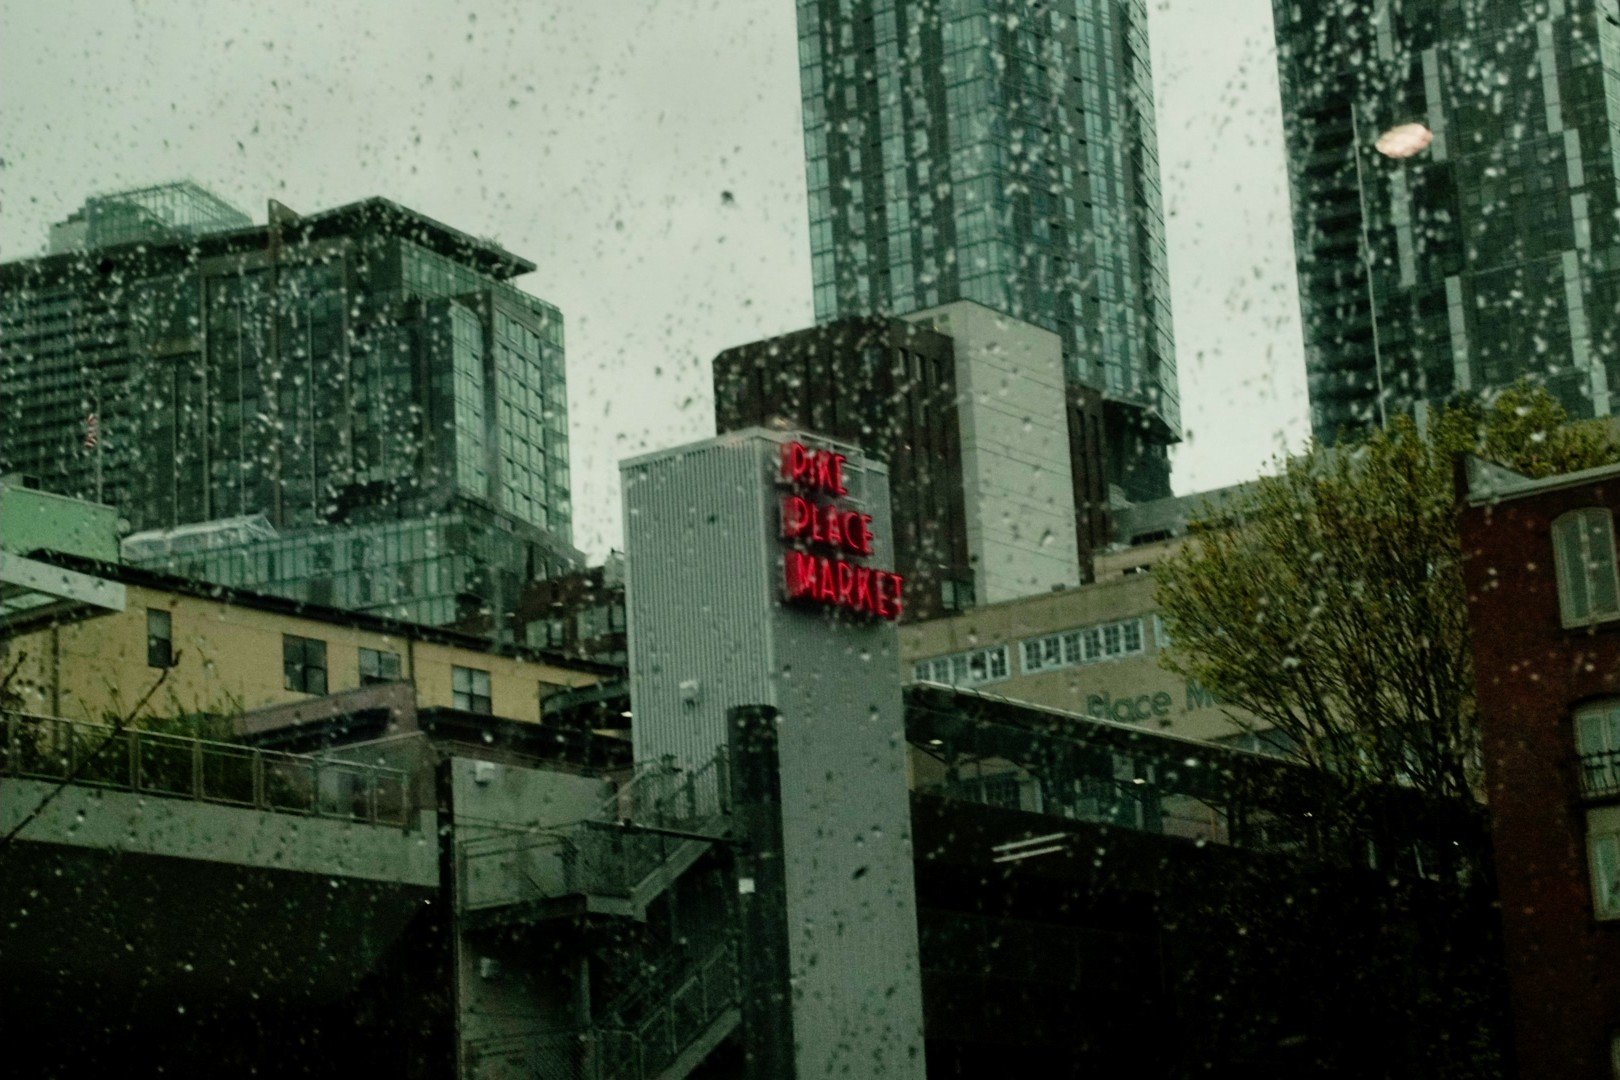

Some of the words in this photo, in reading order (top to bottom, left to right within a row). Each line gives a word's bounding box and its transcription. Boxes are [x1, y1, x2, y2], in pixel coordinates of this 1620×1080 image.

[779, 440, 848, 496] PIKE
[783, 495, 874, 556] PLACE
[785, 550, 904, 620] MARKET
[1086, 690, 1172, 722] Place
